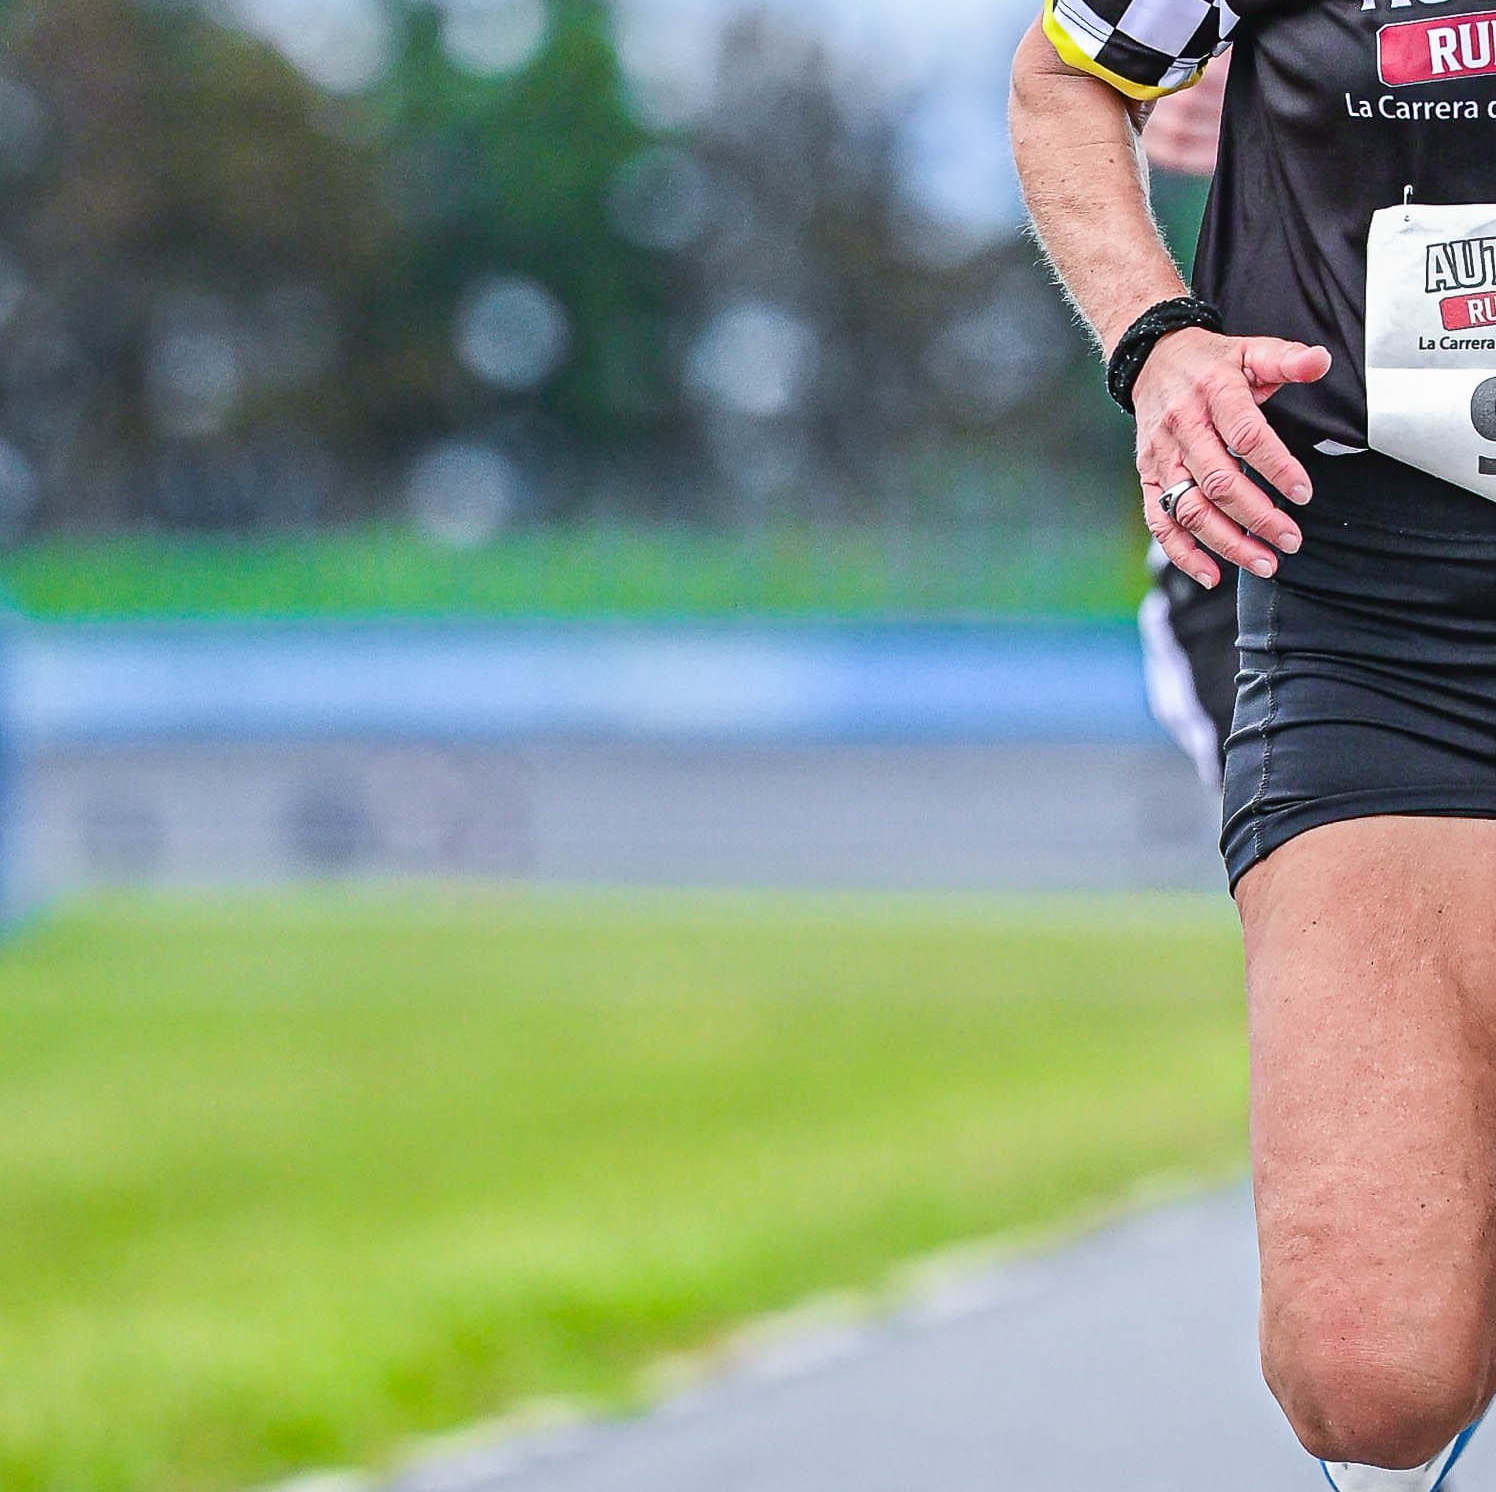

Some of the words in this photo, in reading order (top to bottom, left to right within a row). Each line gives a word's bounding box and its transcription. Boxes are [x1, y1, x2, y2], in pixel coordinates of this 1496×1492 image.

[1345, 92, 1373, 118] La
[1378, 95, 1479, 120] Carrera
[1418, 336, 1436, 350] La
[1440, 336, 1495, 350] Carrera
